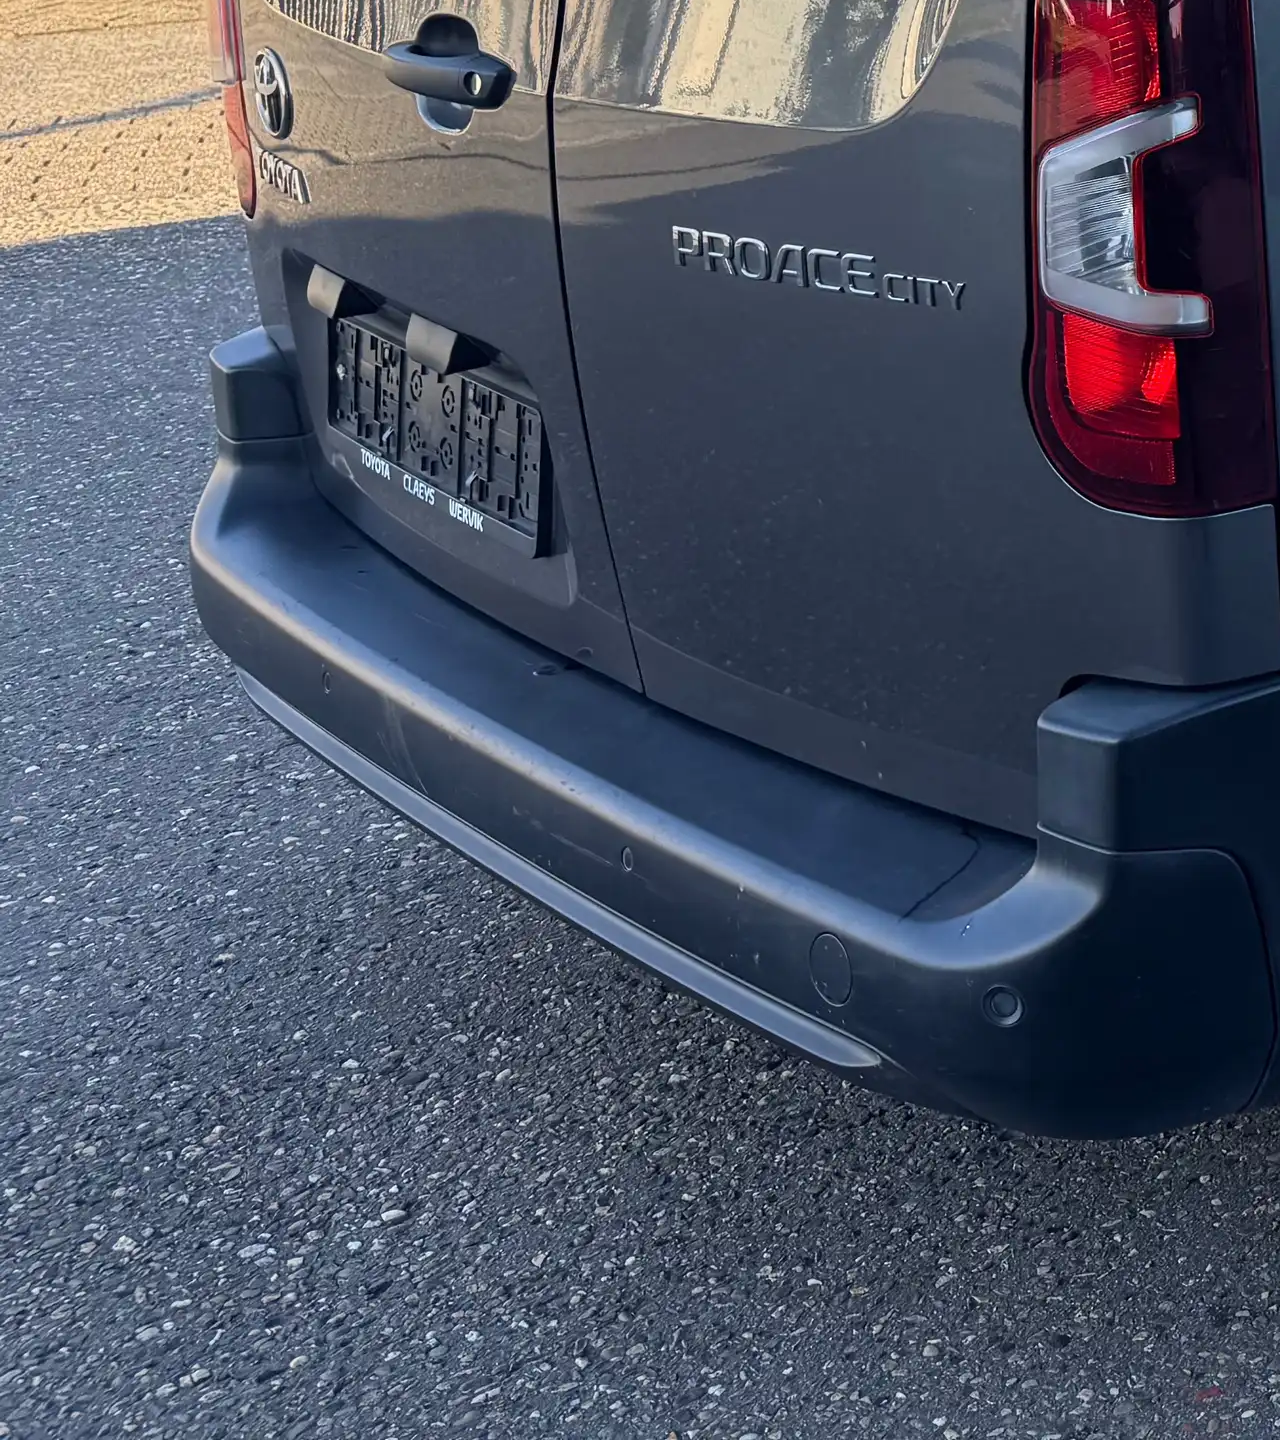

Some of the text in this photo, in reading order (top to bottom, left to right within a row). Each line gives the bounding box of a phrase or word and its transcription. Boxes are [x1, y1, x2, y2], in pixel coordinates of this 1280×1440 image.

[672, 225, 966, 310] PROACE CITY
[360, 448, 484, 533] TOYOTA CLAEYS WERVIK
